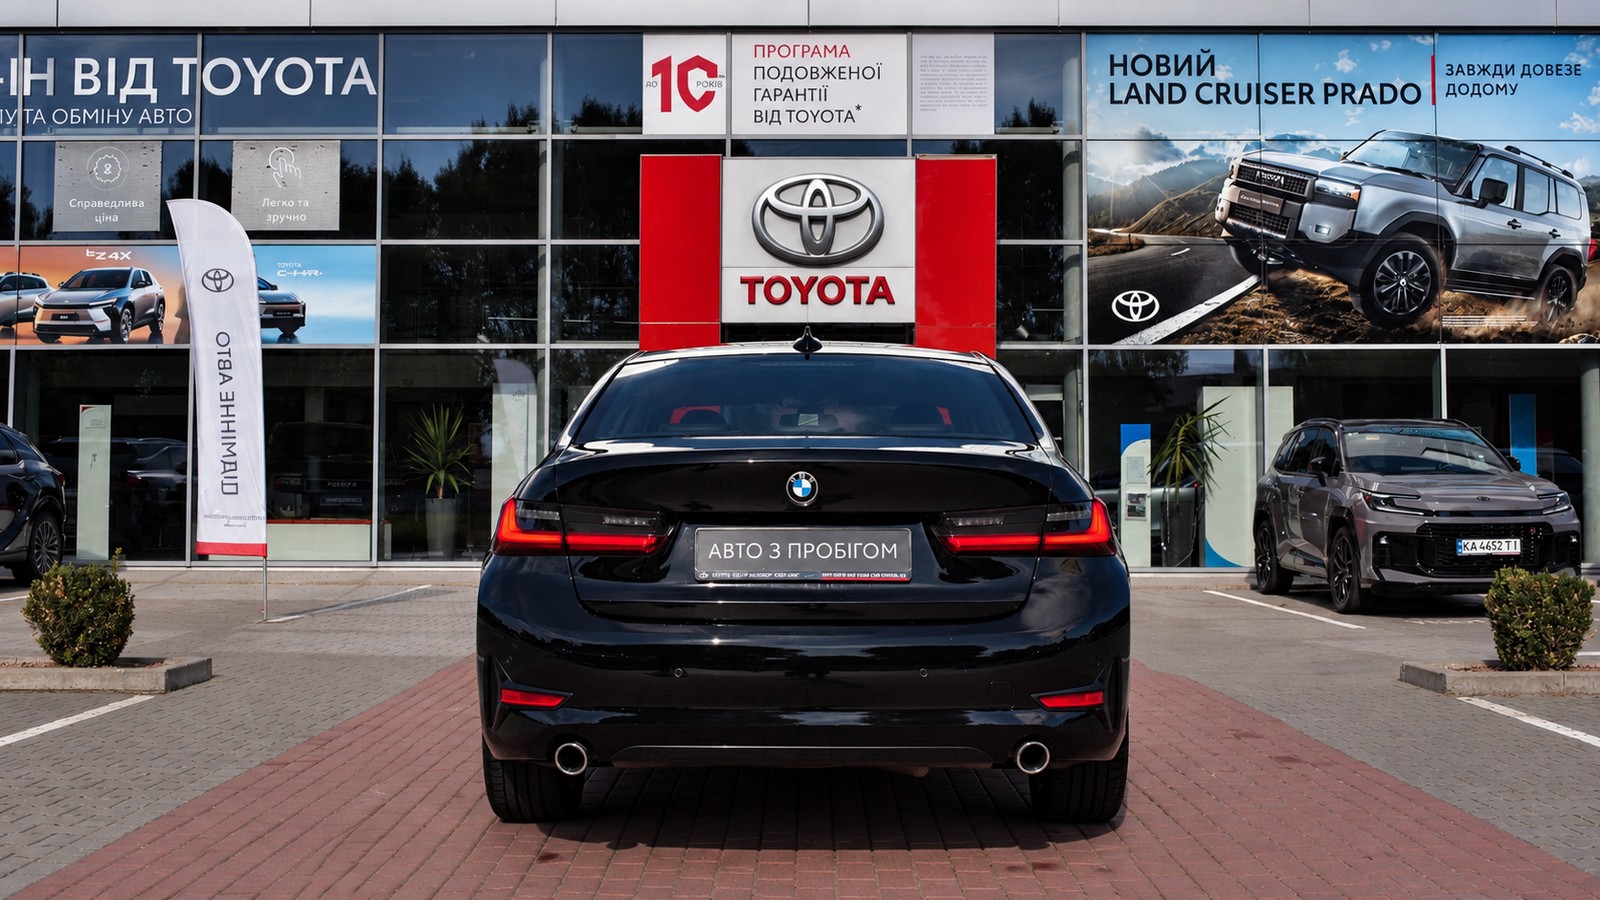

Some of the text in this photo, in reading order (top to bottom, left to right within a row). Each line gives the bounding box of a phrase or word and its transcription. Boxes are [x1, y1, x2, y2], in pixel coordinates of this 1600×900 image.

[753, 44, 851, 59] ПРОГРАМА
[1109, 48, 1216, 77] НОВИЙ
[1445, 63, 1583, 79] ЗАВЖДИ ДОВЕЗЕ
[0, 57, 378, 104] ІН ВІД TOYOTA
[753, 62, 882, 83] ПОДОВЖЕНОЇ
[651, 54, 718, 113] 10
[1445, 83, 1519, 98] ДОДОМУ
[753, 85, 828, 102] ГАРАНТІЇ
[1109, 82, 1422, 105] LAND CRUISER PRADO
[0, 108, 193, 125] У ТА ОБМІНУ АВТО
[753, 109, 782, 126] ВІД
[69, 198, 145, 210] Справедлива
[261, 197, 309, 208] Легко та
[94, 212, 119, 224] ціна
[266, 213, 307, 224] зручно
[739, 275, 896, 305] TOYOTA
[708, 542, 898, 560] АВТО З ПРОБІГОМ
